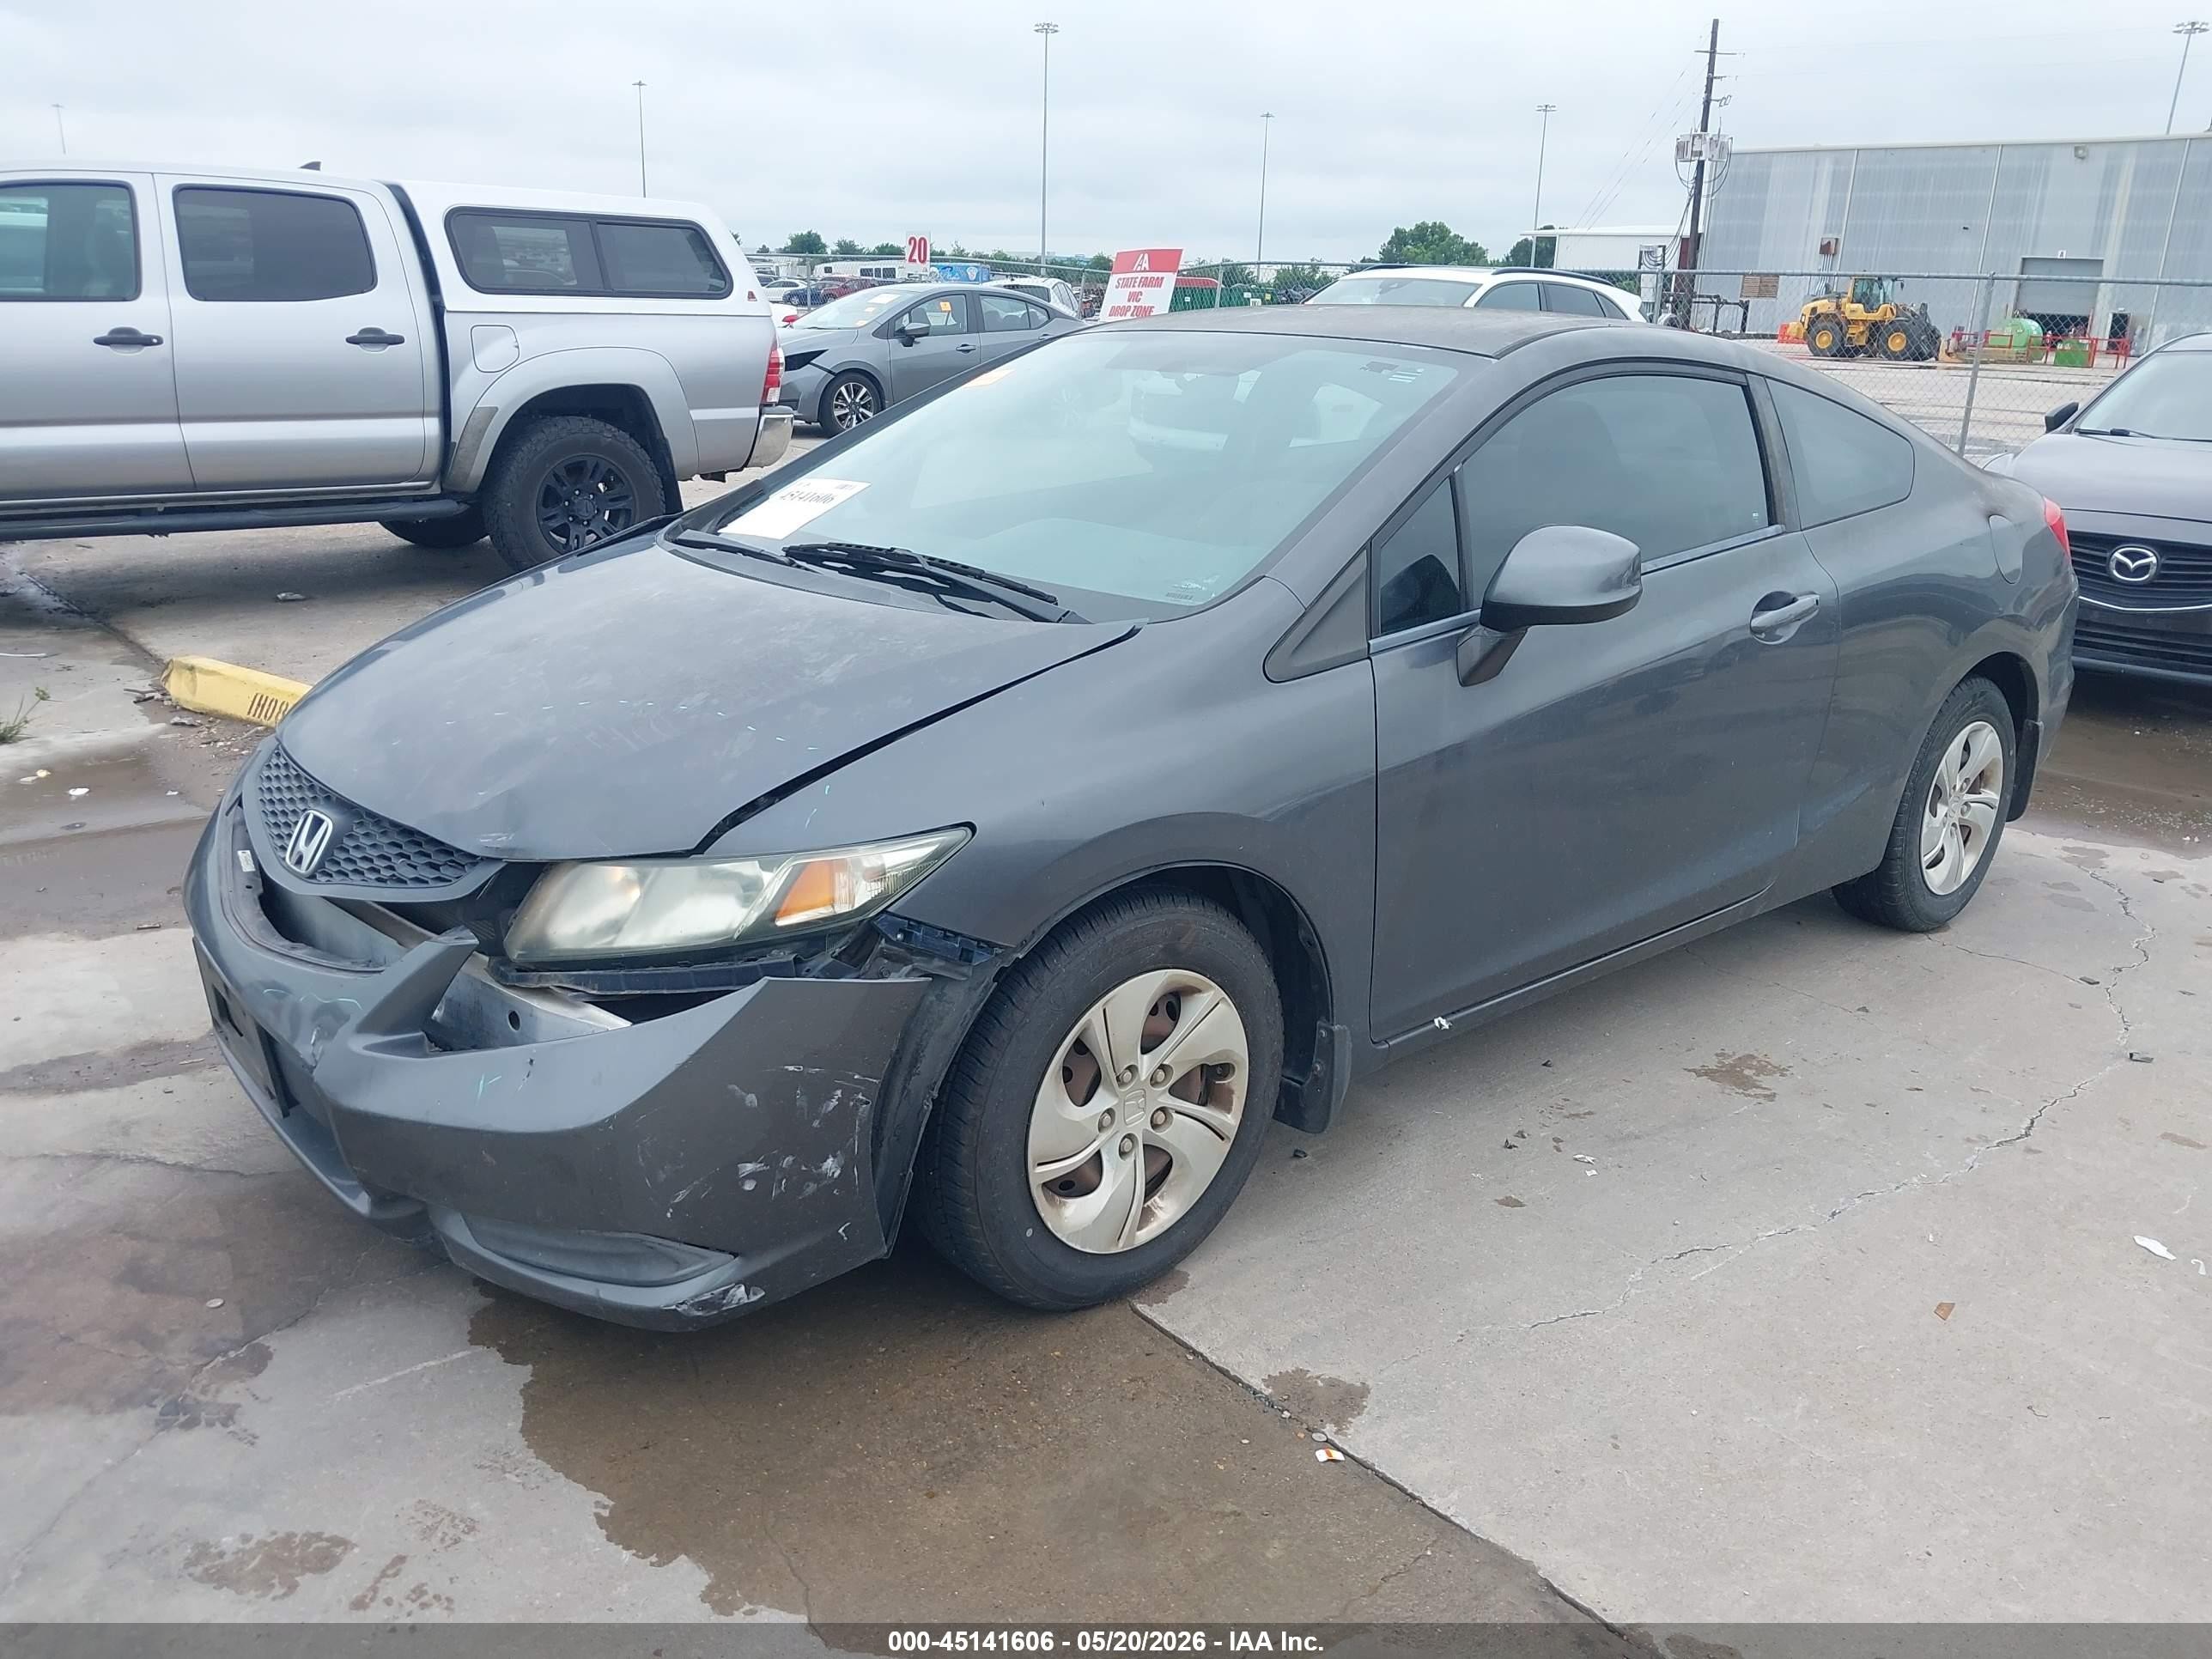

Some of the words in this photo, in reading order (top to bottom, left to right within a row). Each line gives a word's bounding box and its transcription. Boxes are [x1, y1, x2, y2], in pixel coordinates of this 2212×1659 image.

[908, 236, 927, 264] 20
[1115, 276, 1139, 289] STATE
[1138, 276, 1164, 289] FARM
[1127, 291, 1143, 303] VIC
[1108, 305, 1131, 317] DROP
[1130, 305, 1155, 317] ZONE
